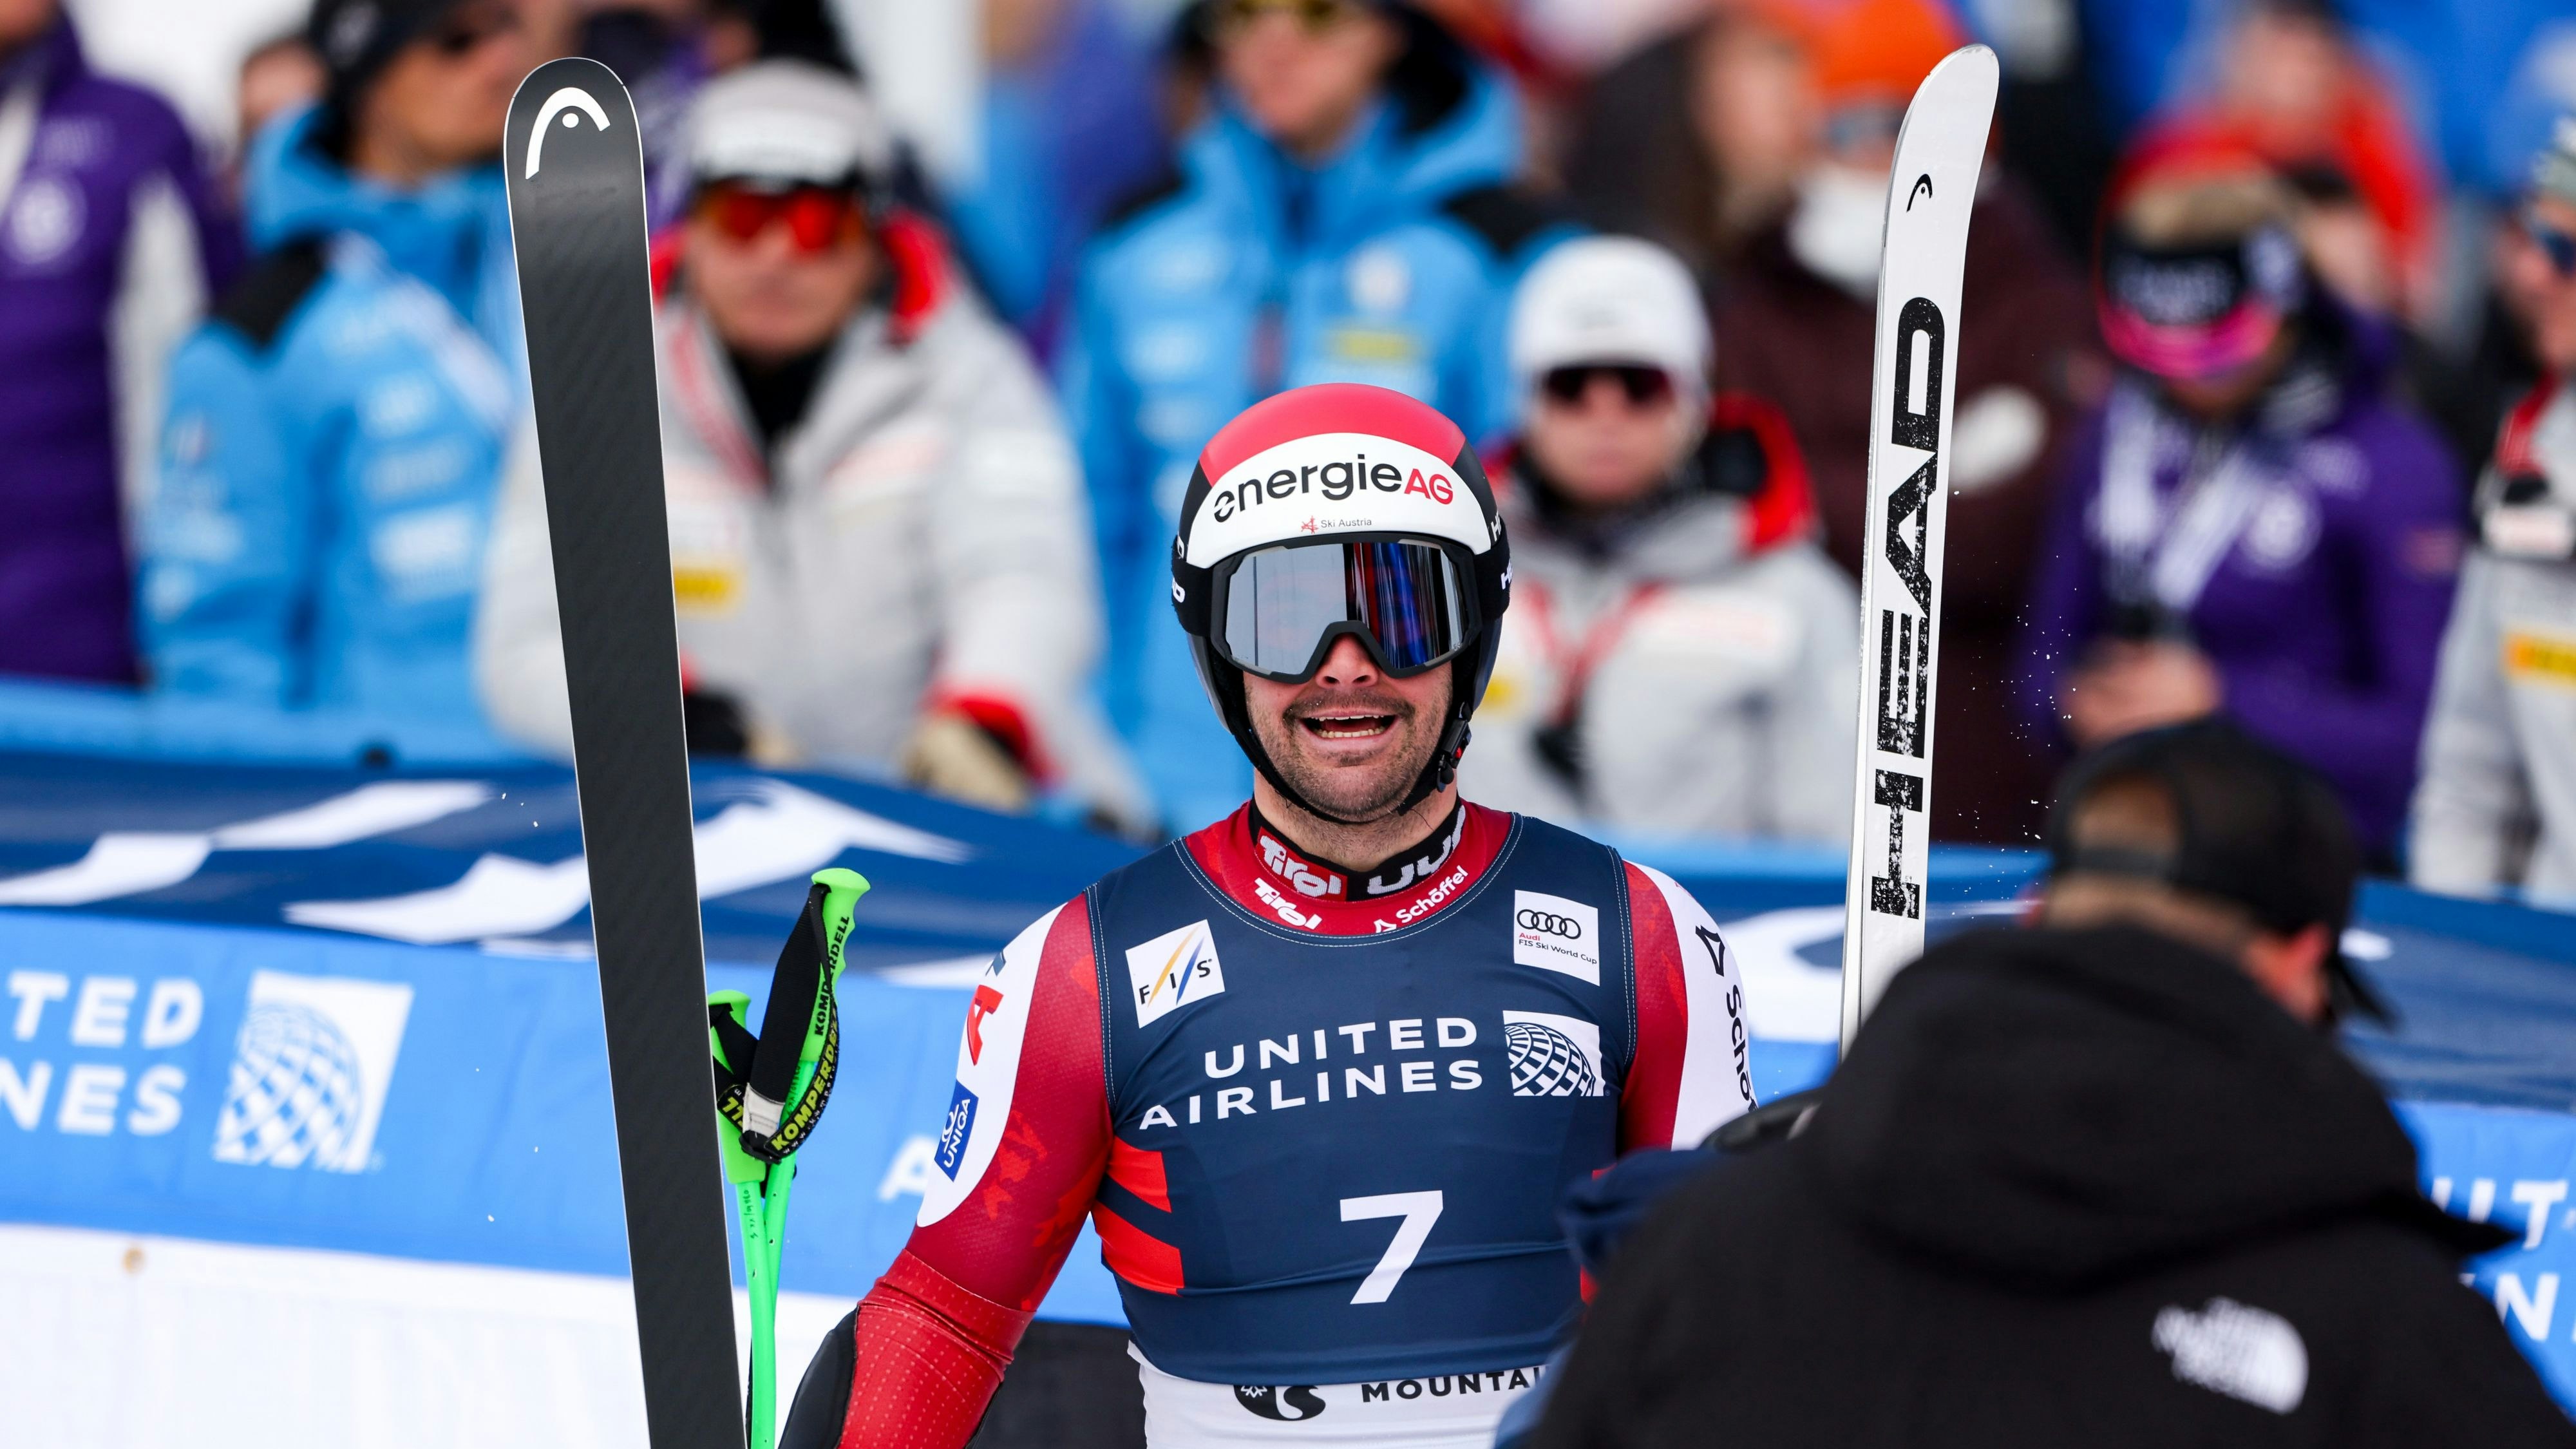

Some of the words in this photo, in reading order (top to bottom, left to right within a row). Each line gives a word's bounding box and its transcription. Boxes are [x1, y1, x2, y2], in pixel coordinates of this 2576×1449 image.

[1321, 519, 1336, 528] Ski
[1338, 518, 1372, 527] Austria
[1871, 297, 1945, 919] HEAD
[1260, 835, 1341, 897] Tirol
[1255, 877, 1322, 929] Tirol
[1519, 932, 1540, 941] Audi
[1519, 939, 1534, 947] FIS
[1551, 945, 1578, 958] World
[1580, 953, 1597, 965] Cup
[814, 916, 849, 1036] KOMPRDELL
[1139, 960, 1211, 1005] FIS
[1205, 1018, 1477, 1079] UNITED
[1139, 1059, 1482, 1130] AIRLINES
[943, 1098, 971, 1168] UNIQA
[1340, 1190, 1444, 1305] 7
